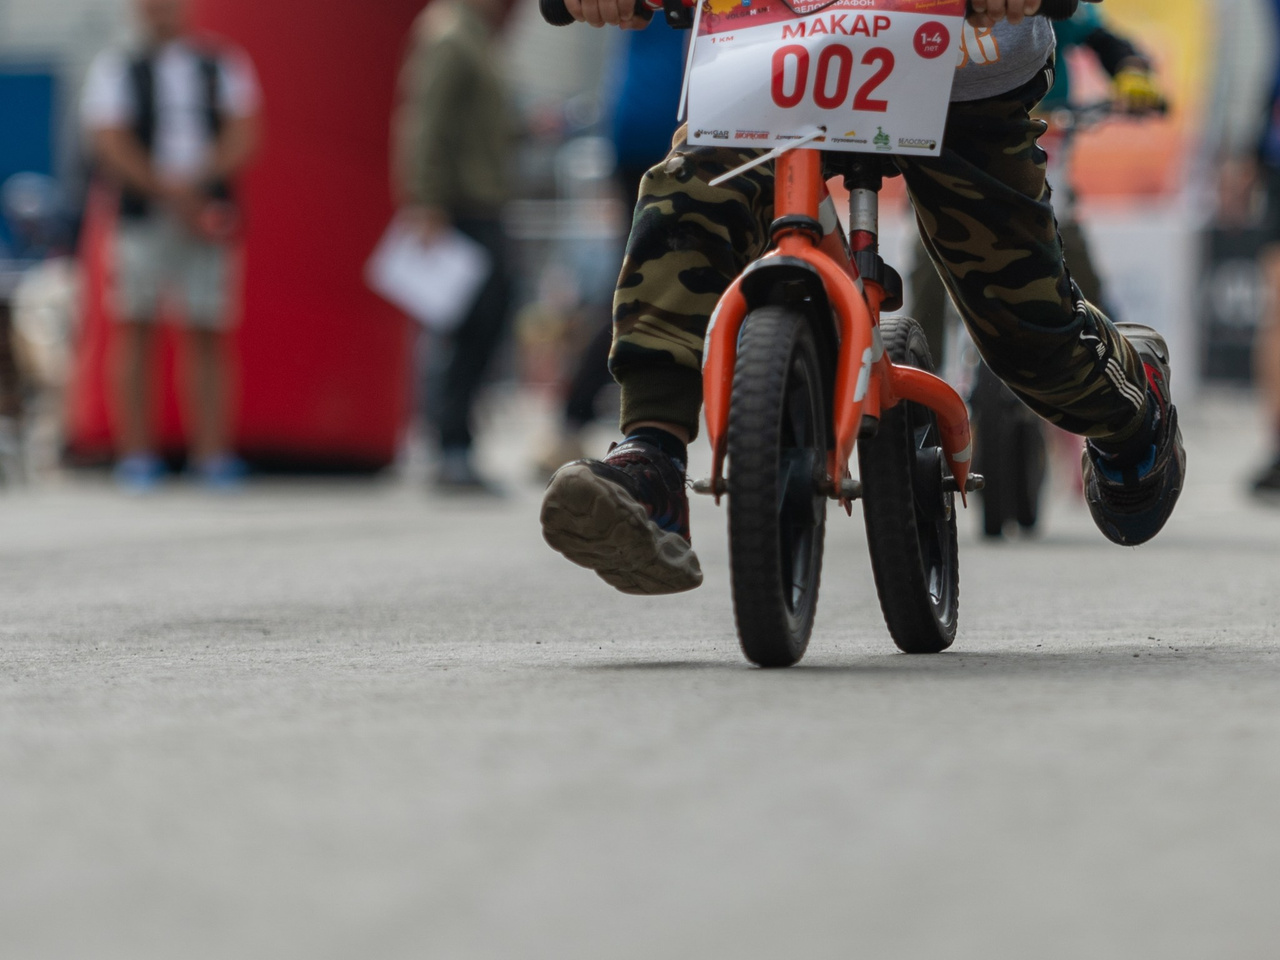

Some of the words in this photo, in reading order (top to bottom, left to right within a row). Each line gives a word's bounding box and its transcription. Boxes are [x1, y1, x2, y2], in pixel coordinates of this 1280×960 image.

[781, 14, 891, 40] МАКАР
[920, 32, 942, 45] 1-4
[771, 43, 895, 112] 002
